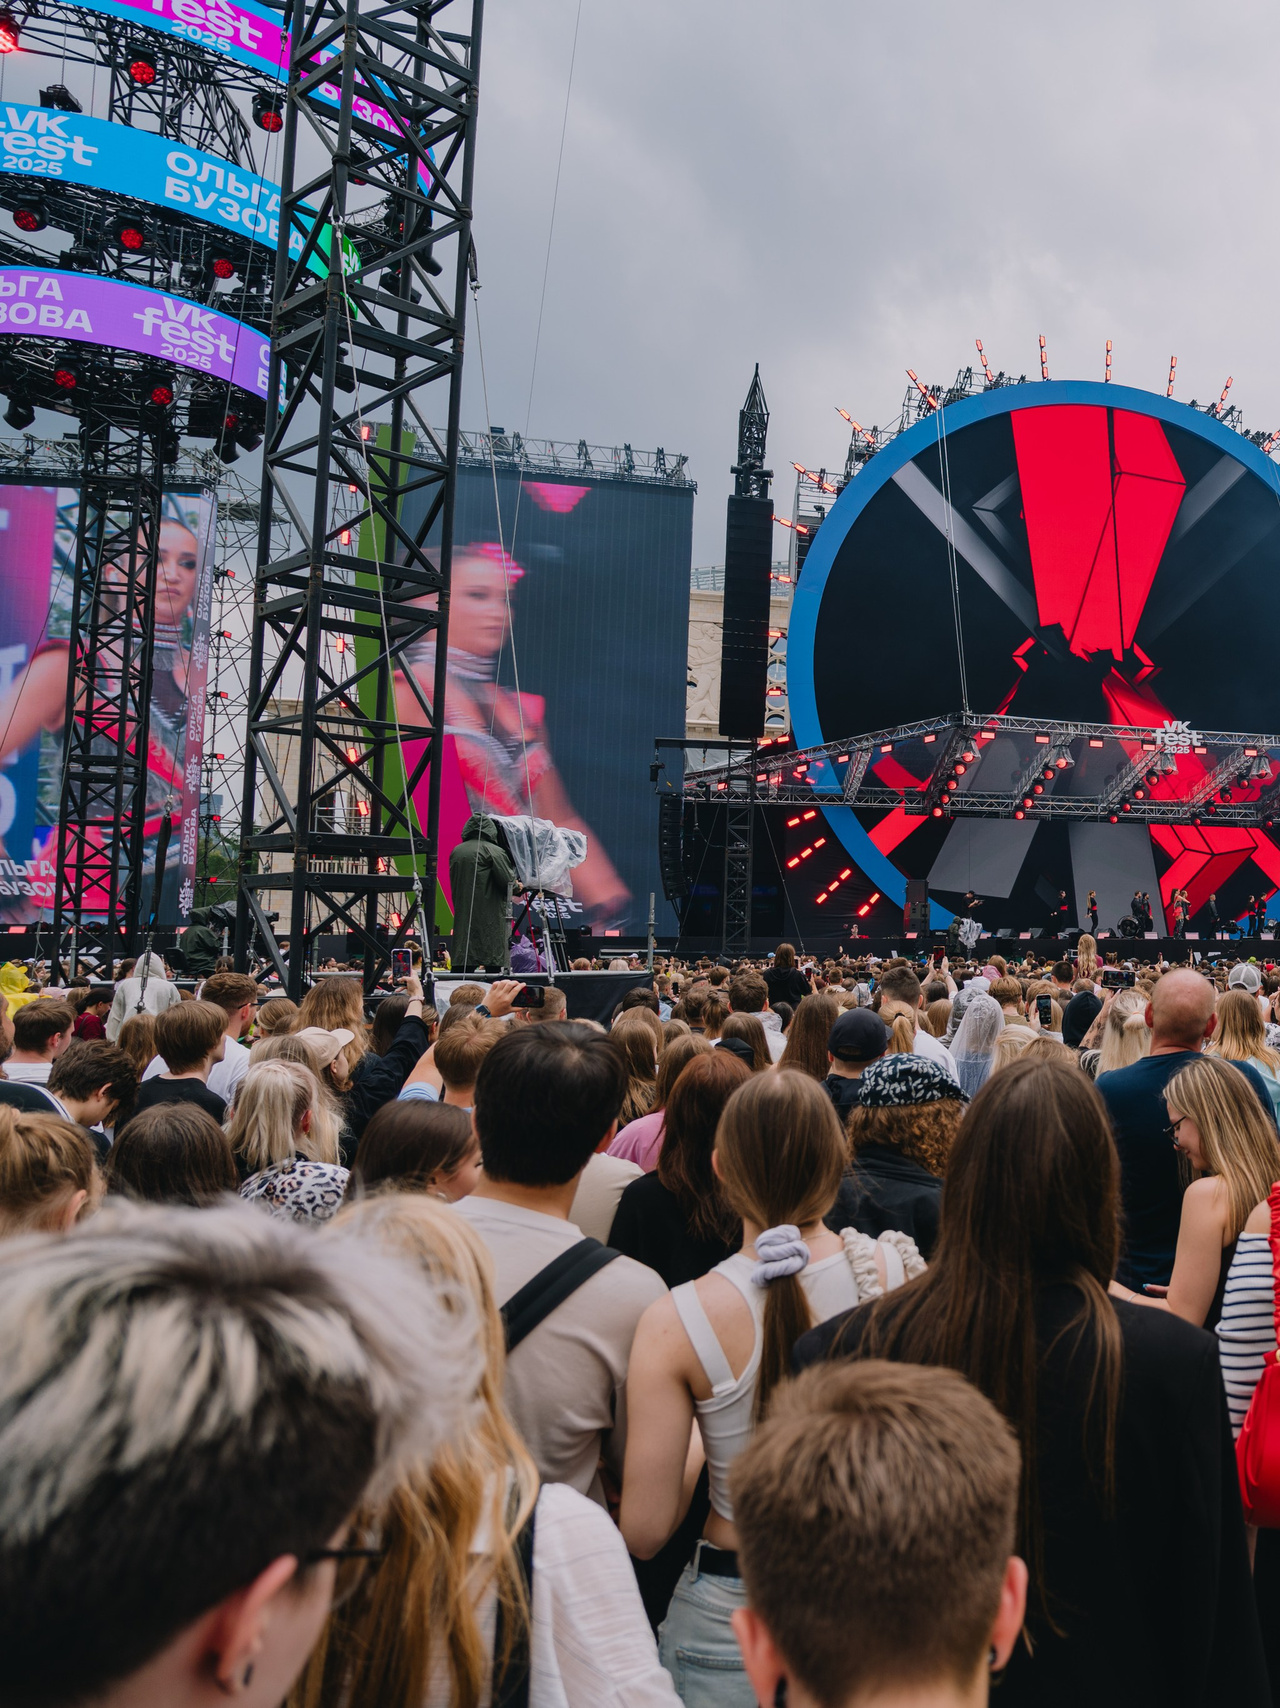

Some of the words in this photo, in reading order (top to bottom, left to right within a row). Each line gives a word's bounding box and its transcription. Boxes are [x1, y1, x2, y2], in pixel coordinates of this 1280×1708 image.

[171, 20, 231, 51] 2025
[5, 107, 70, 138] VK
[0, 121, 98, 166] est
[2, 155, 63, 176] 2025
[162, 297, 218, 335] VK
[133, 307, 236, 364] fest
[160, 343, 212, 370] 2025
[202, 565, 212, 622] БУЗОВА
[192, 639, 200, 661] VK
[196, 632, 206, 671] fest
[195, 686, 205, 743] БУЗОВА
[1163, 720, 1191, 733] VK
[1152, 729, 1203, 746] fest
[1164, 746, 1190, 754] 2025
[185, 763, 193, 785] VK
[188, 754, 198, 794] fest
[182, 817, 191, 865] ОЛЬГА
[188, 808, 198, 865] БУЗОВА
[178, 887, 186, 909] VK
[181, 877, 191, 918] fest
